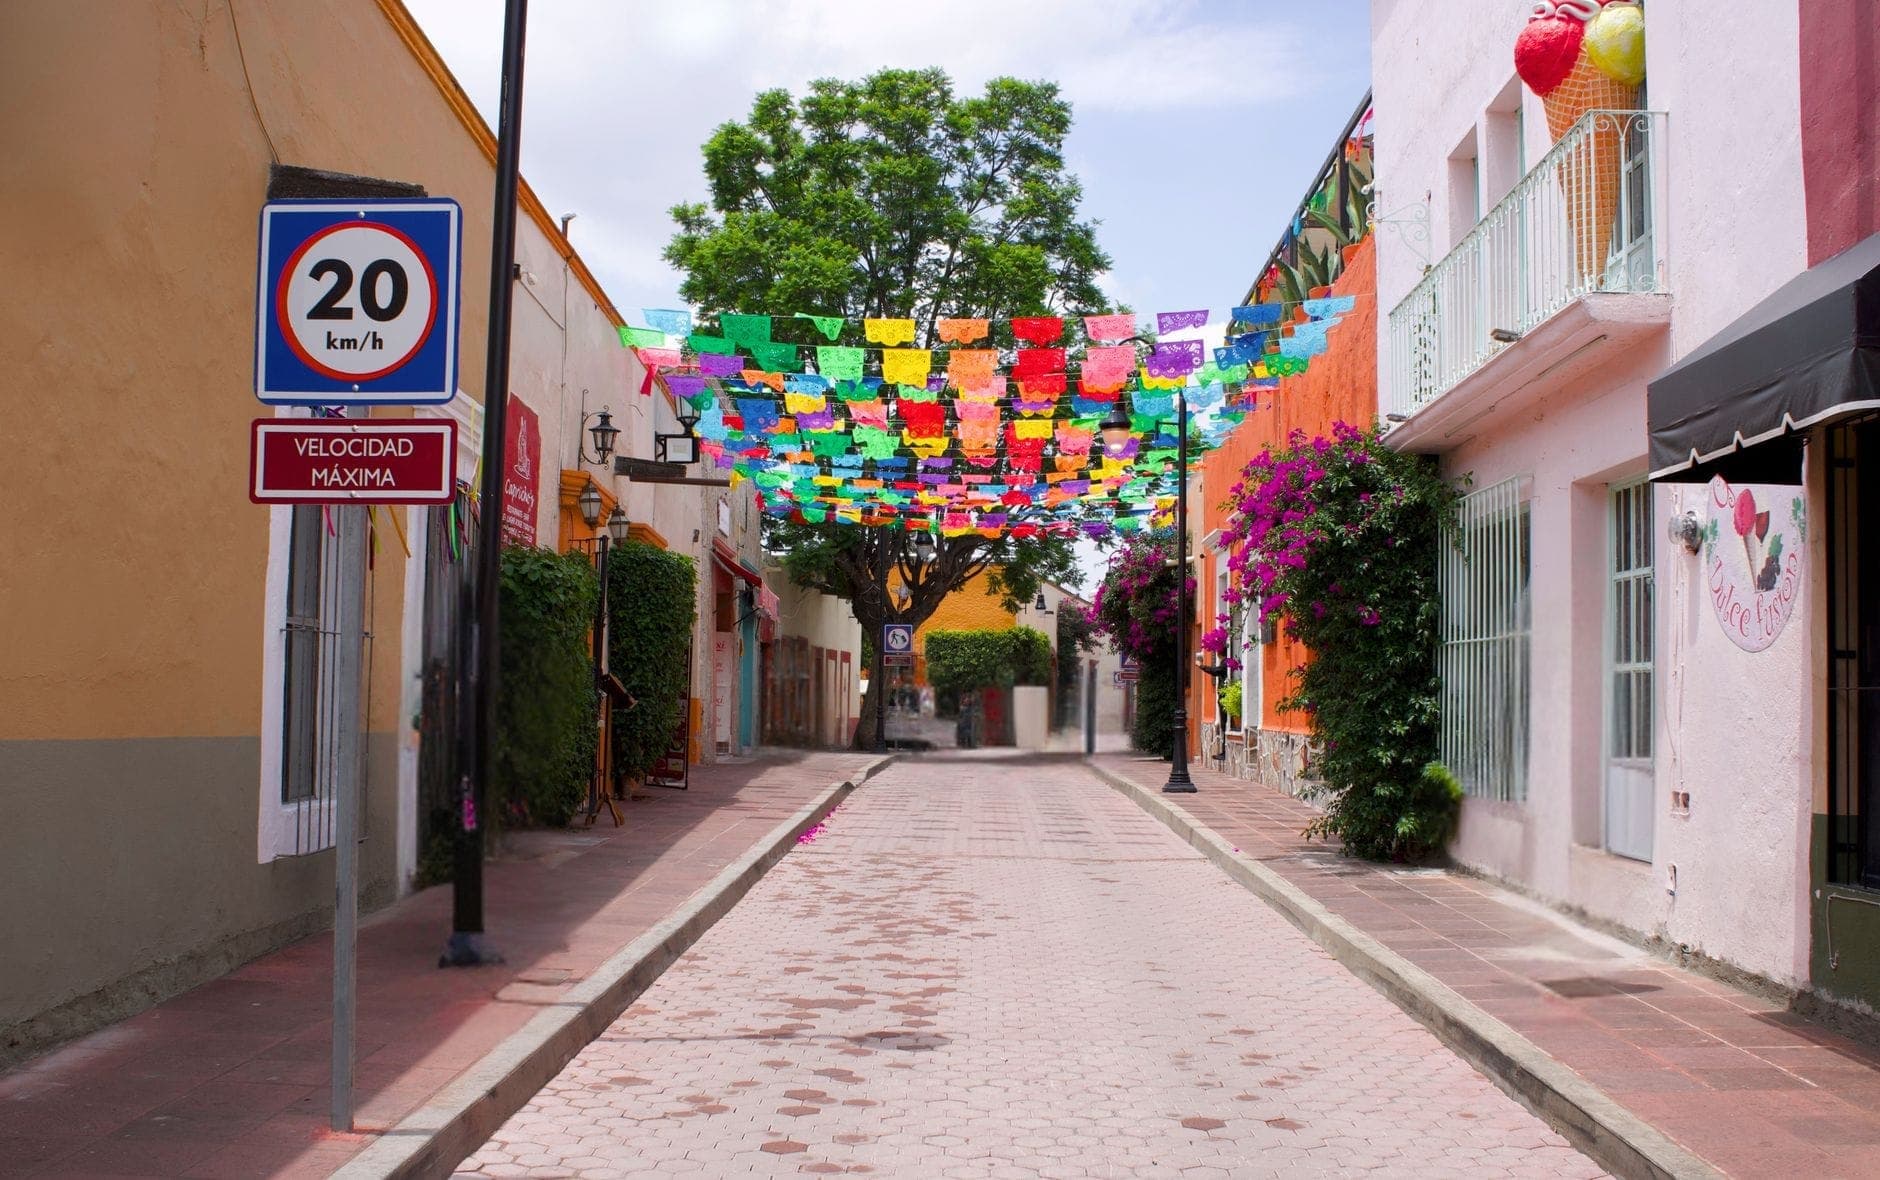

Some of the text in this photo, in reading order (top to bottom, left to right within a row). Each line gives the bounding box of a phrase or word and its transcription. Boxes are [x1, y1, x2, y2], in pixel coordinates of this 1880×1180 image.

[306, 258, 409, 322] 20
[326, 331, 384, 351] km/h
[294, 438, 413, 457] VELOCIDAD
[311, 464, 395, 487] MÁXIMA
[1711, 555, 1750, 637] Dulce
